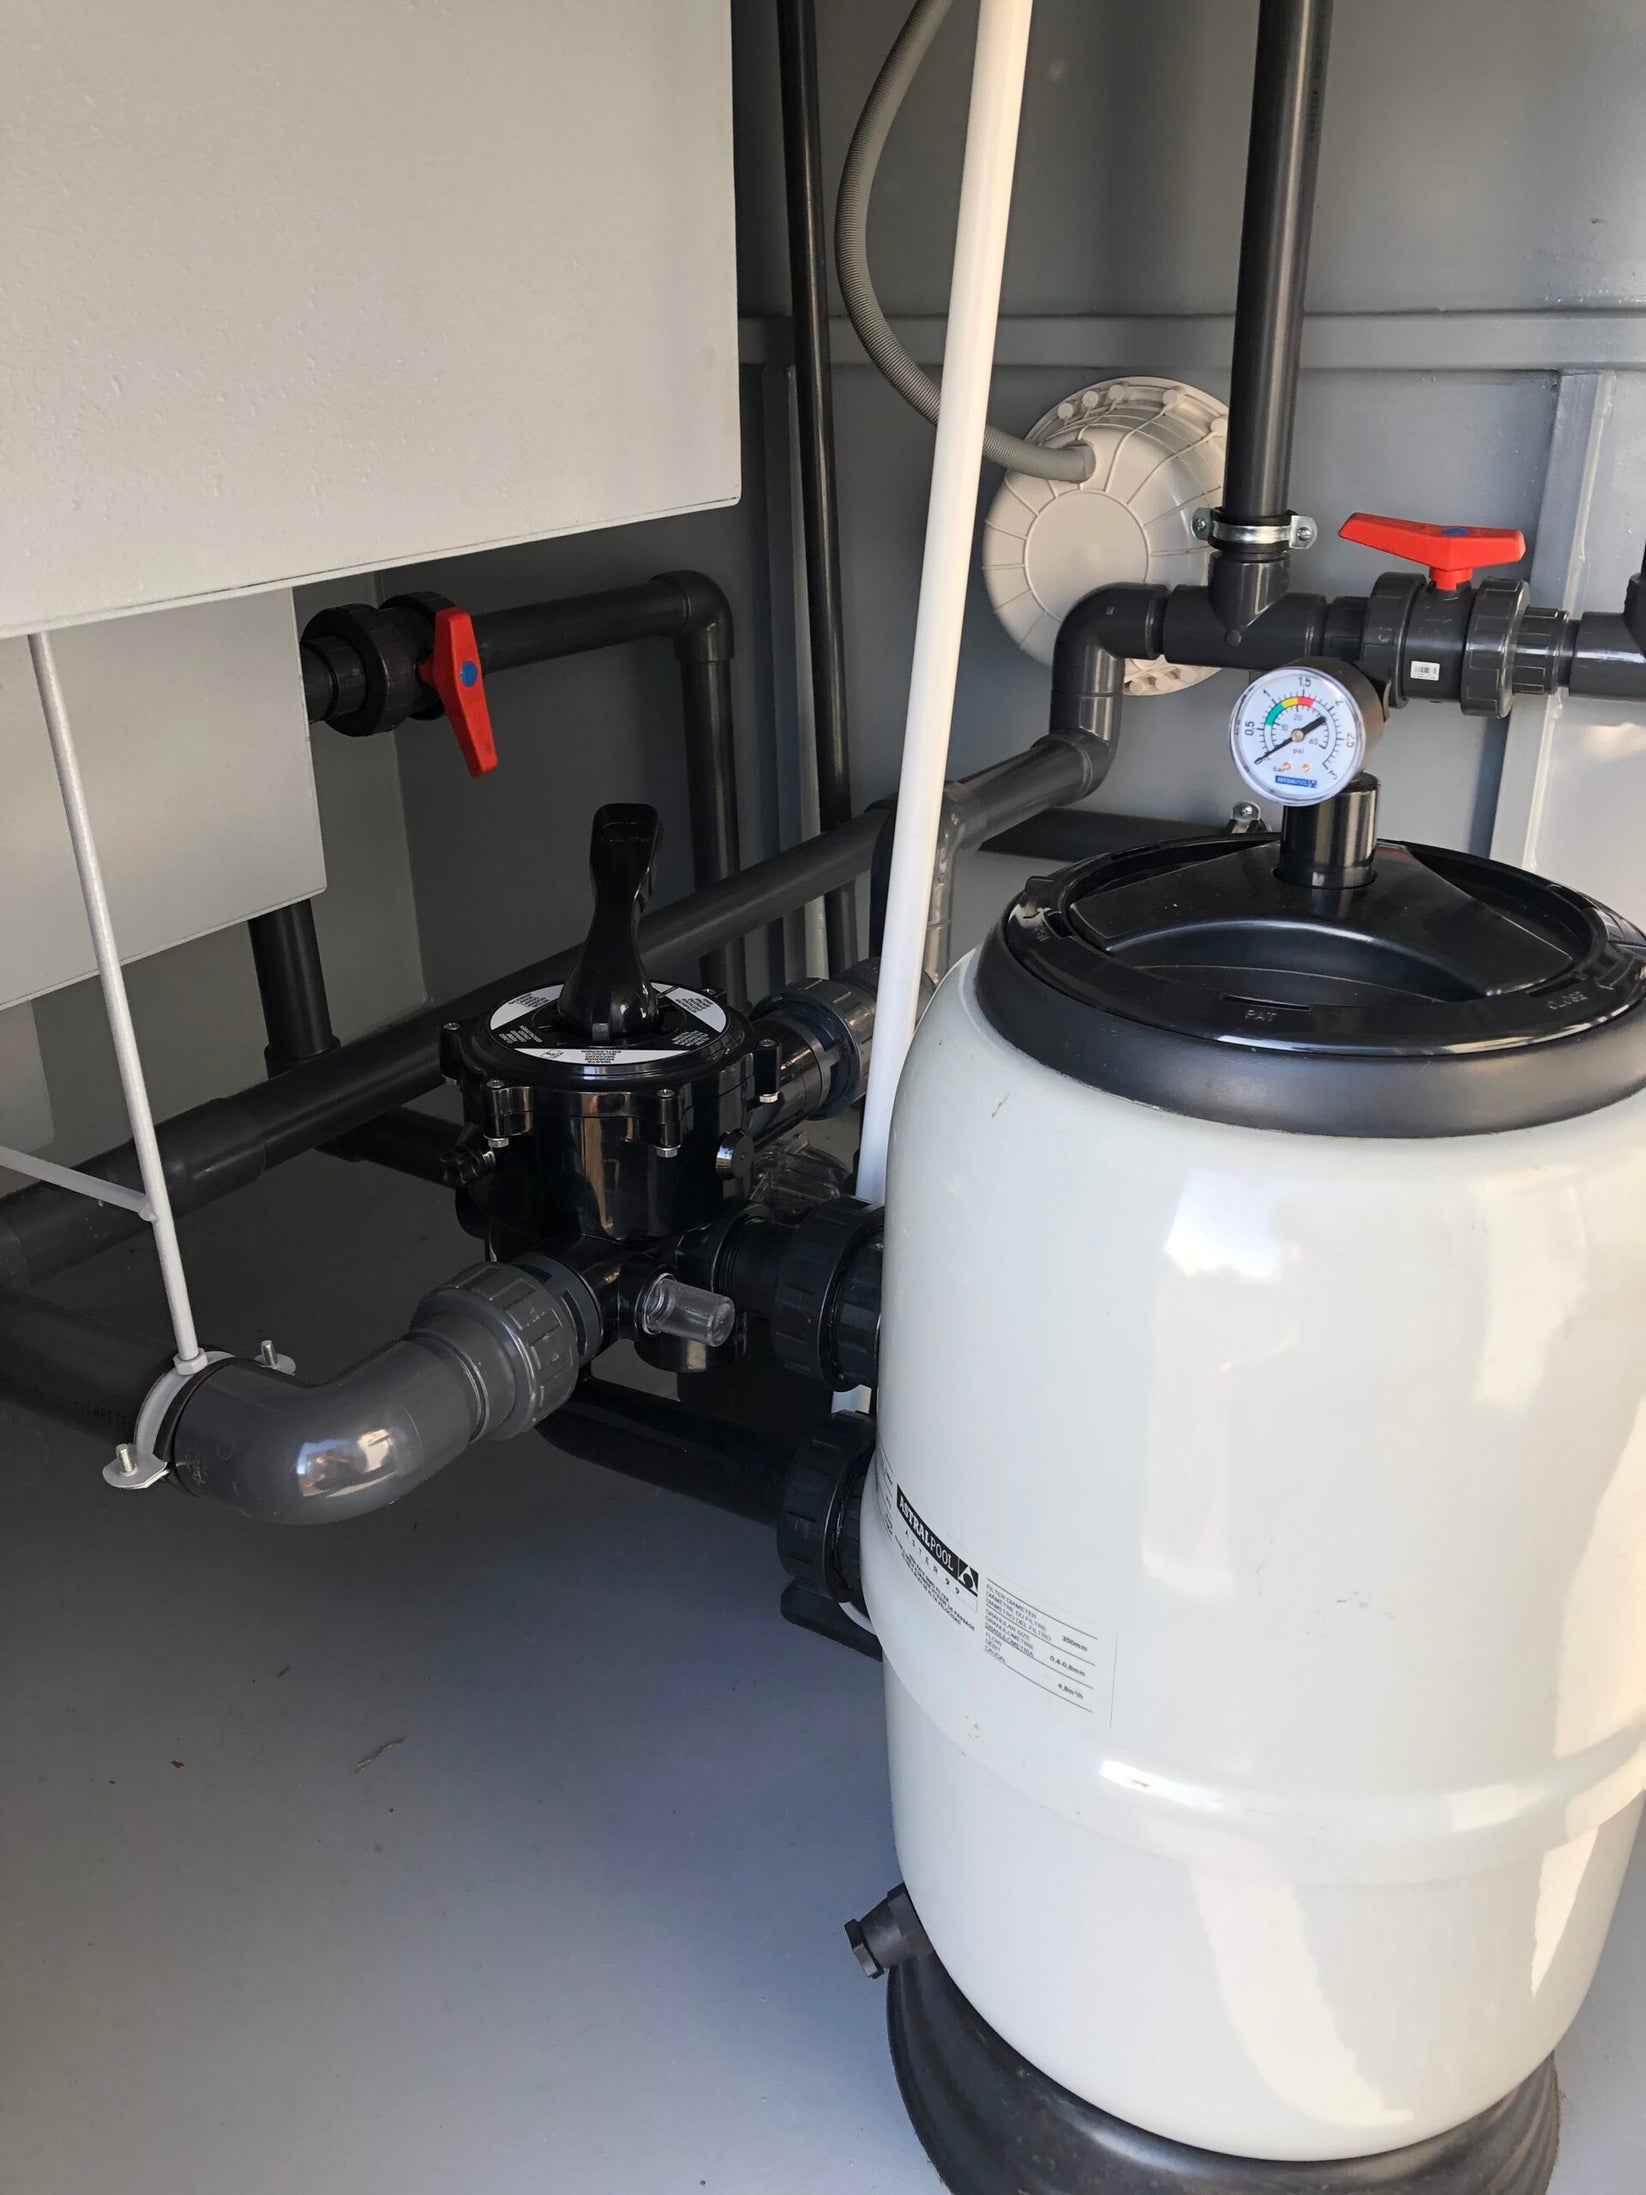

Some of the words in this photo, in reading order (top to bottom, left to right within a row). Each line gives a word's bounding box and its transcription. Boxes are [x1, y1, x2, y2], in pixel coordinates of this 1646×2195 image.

[1264, 690, 1270, 698] 1
[1547, 991, 1588, 1010] CLOSE
[900, 1494, 954, 1572] ASTRALPOOL
[986, 1584, 1006, 1599] FILTER
[1006, 1597, 1037, 1619] DIAMETER
[1016, 1610, 1025, 1619] DU
[1025, 1616, 1046, 1632] FILTRE
[1016, 1617, 1027, 1628] DEL
[1028, 1624, 1052, 1641] FILTRO
[985, 1631, 1002, 1646] FLOW
[1062, 1635, 1088, 1652] 350mm
